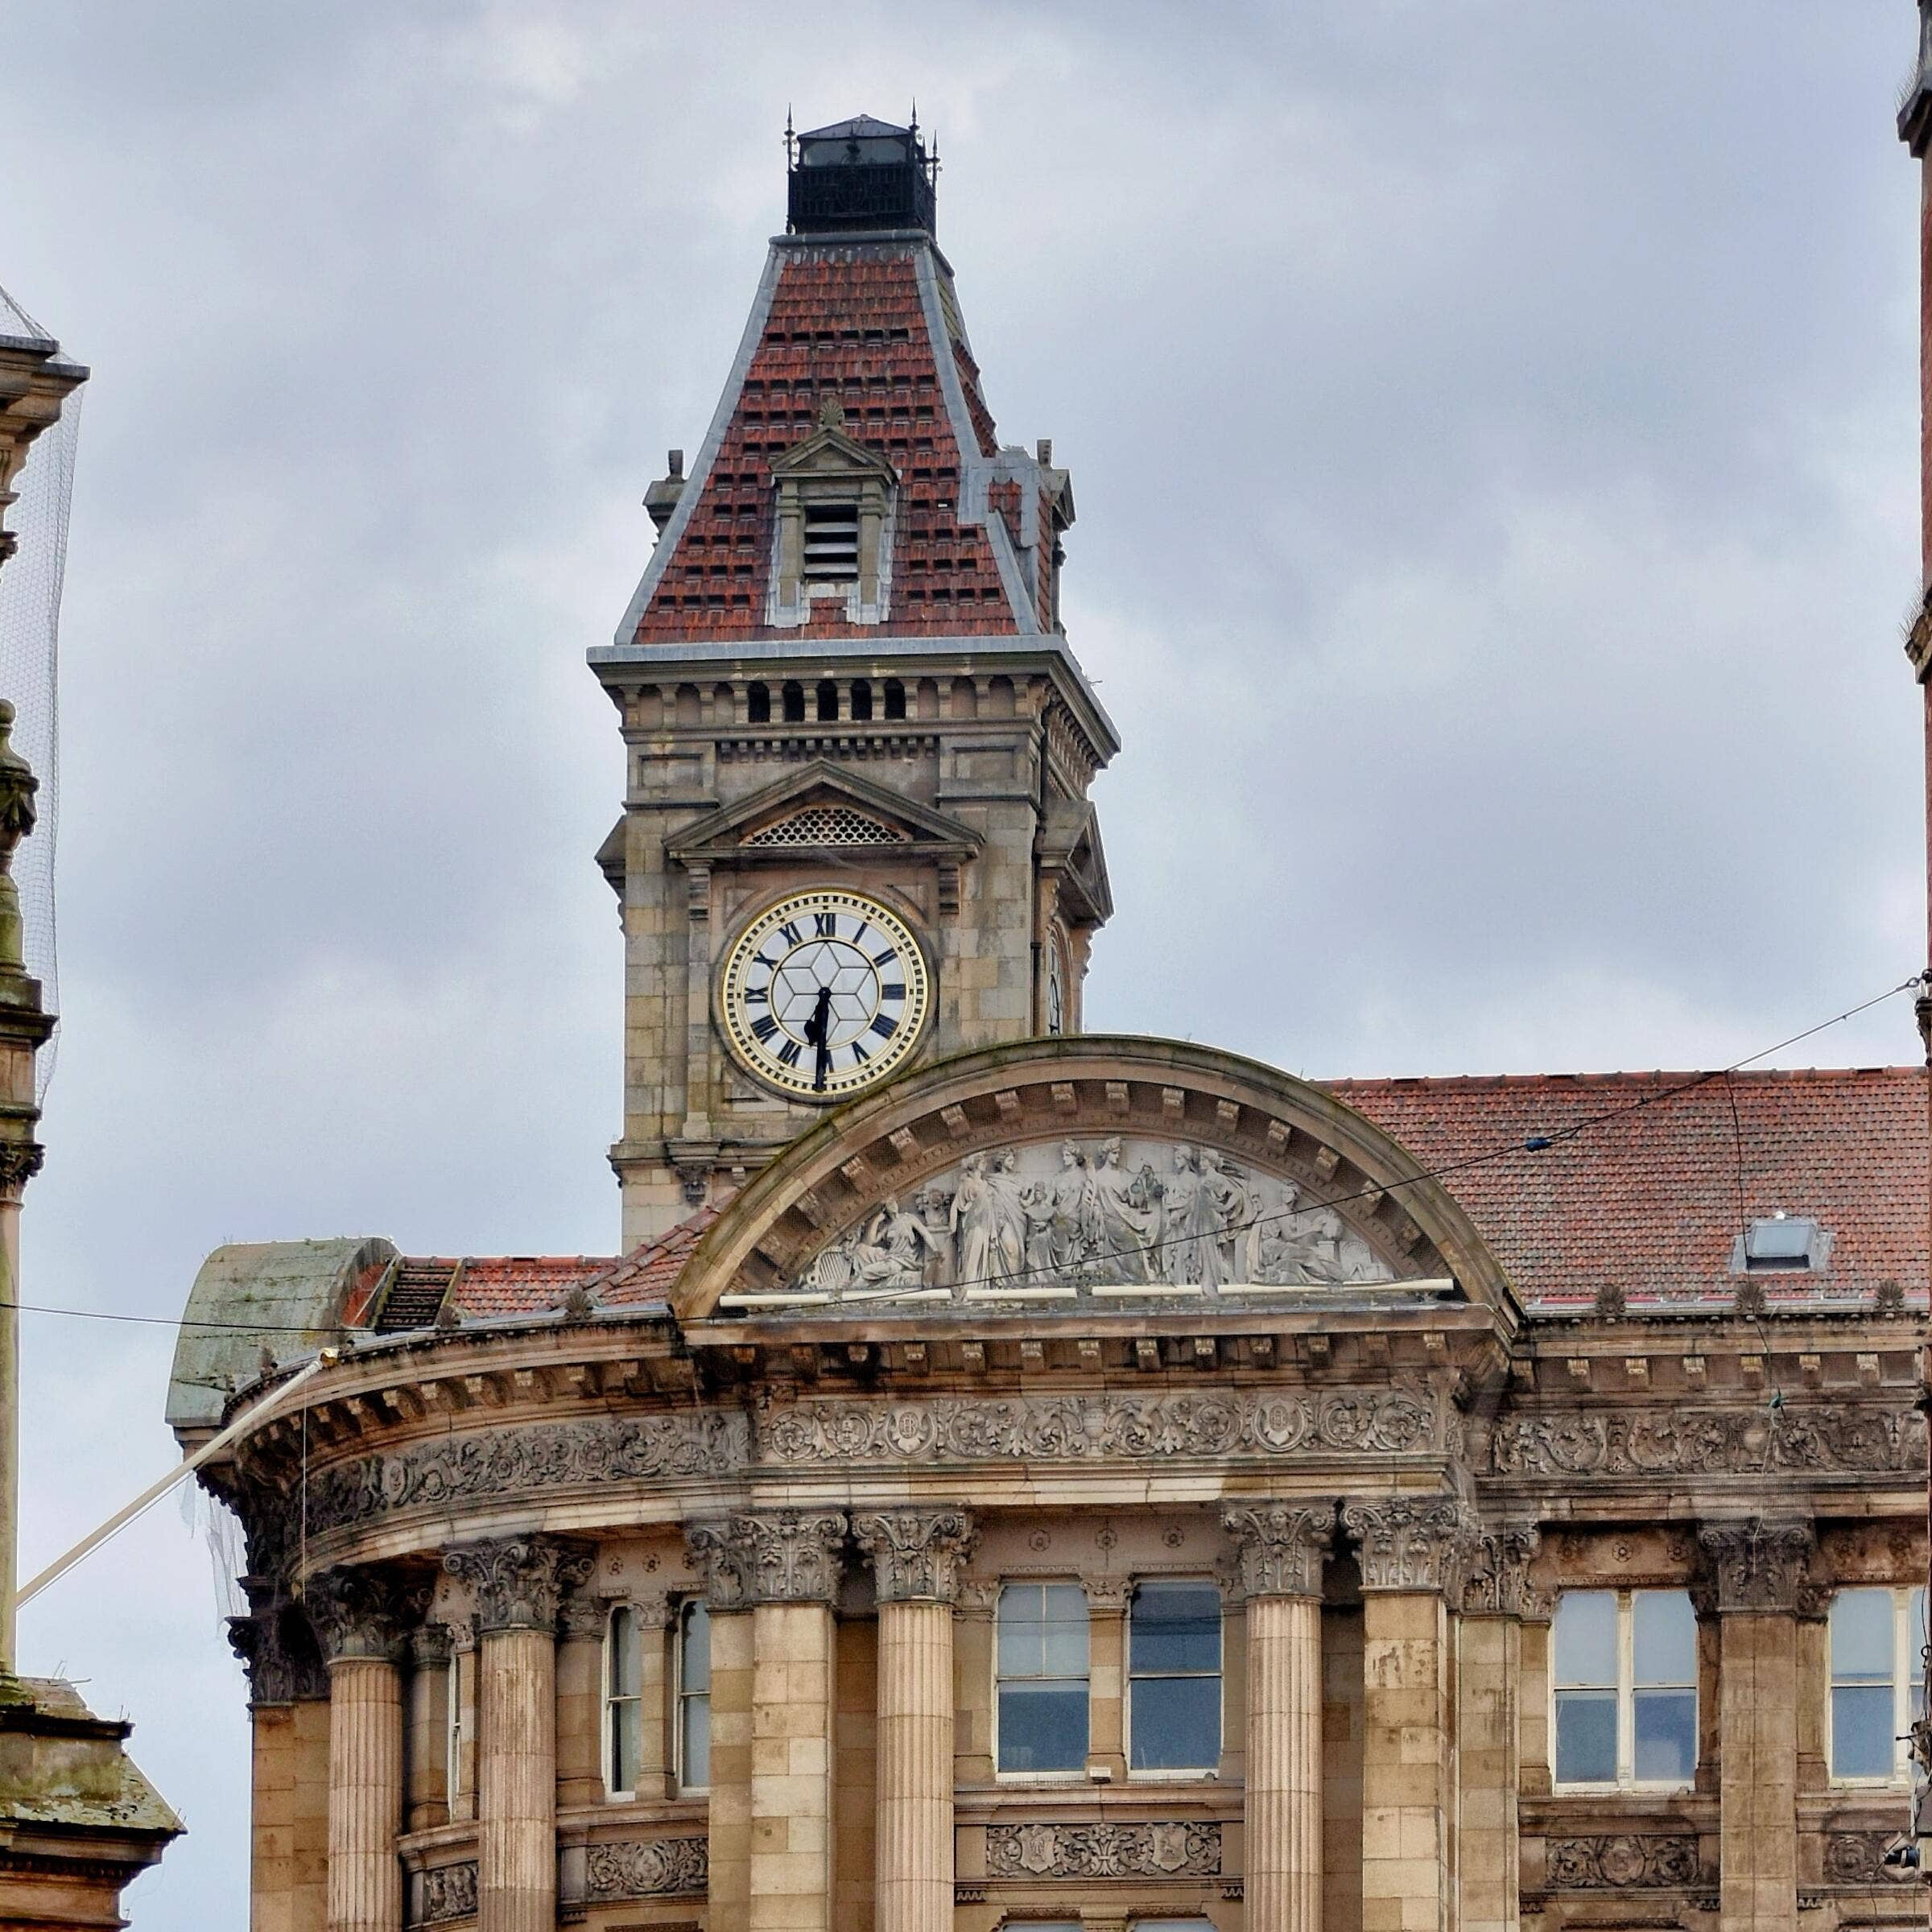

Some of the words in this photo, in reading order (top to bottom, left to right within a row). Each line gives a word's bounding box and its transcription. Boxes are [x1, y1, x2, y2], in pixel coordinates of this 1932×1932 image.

[778, 920, 803, 949] XI
[814, 913, 836, 937] XII
[852, 921, 869, 945] I
[753, 950, 778, 971] X
[873, 947, 898, 967] II
[745, 986, 768, 1004] IX
[882, 984, 906, 1000] III
[750, 1014, 779, 1045] VIII
[777, 1038, 802, 1068] VII
[852, 1041, 869, 1064] V
